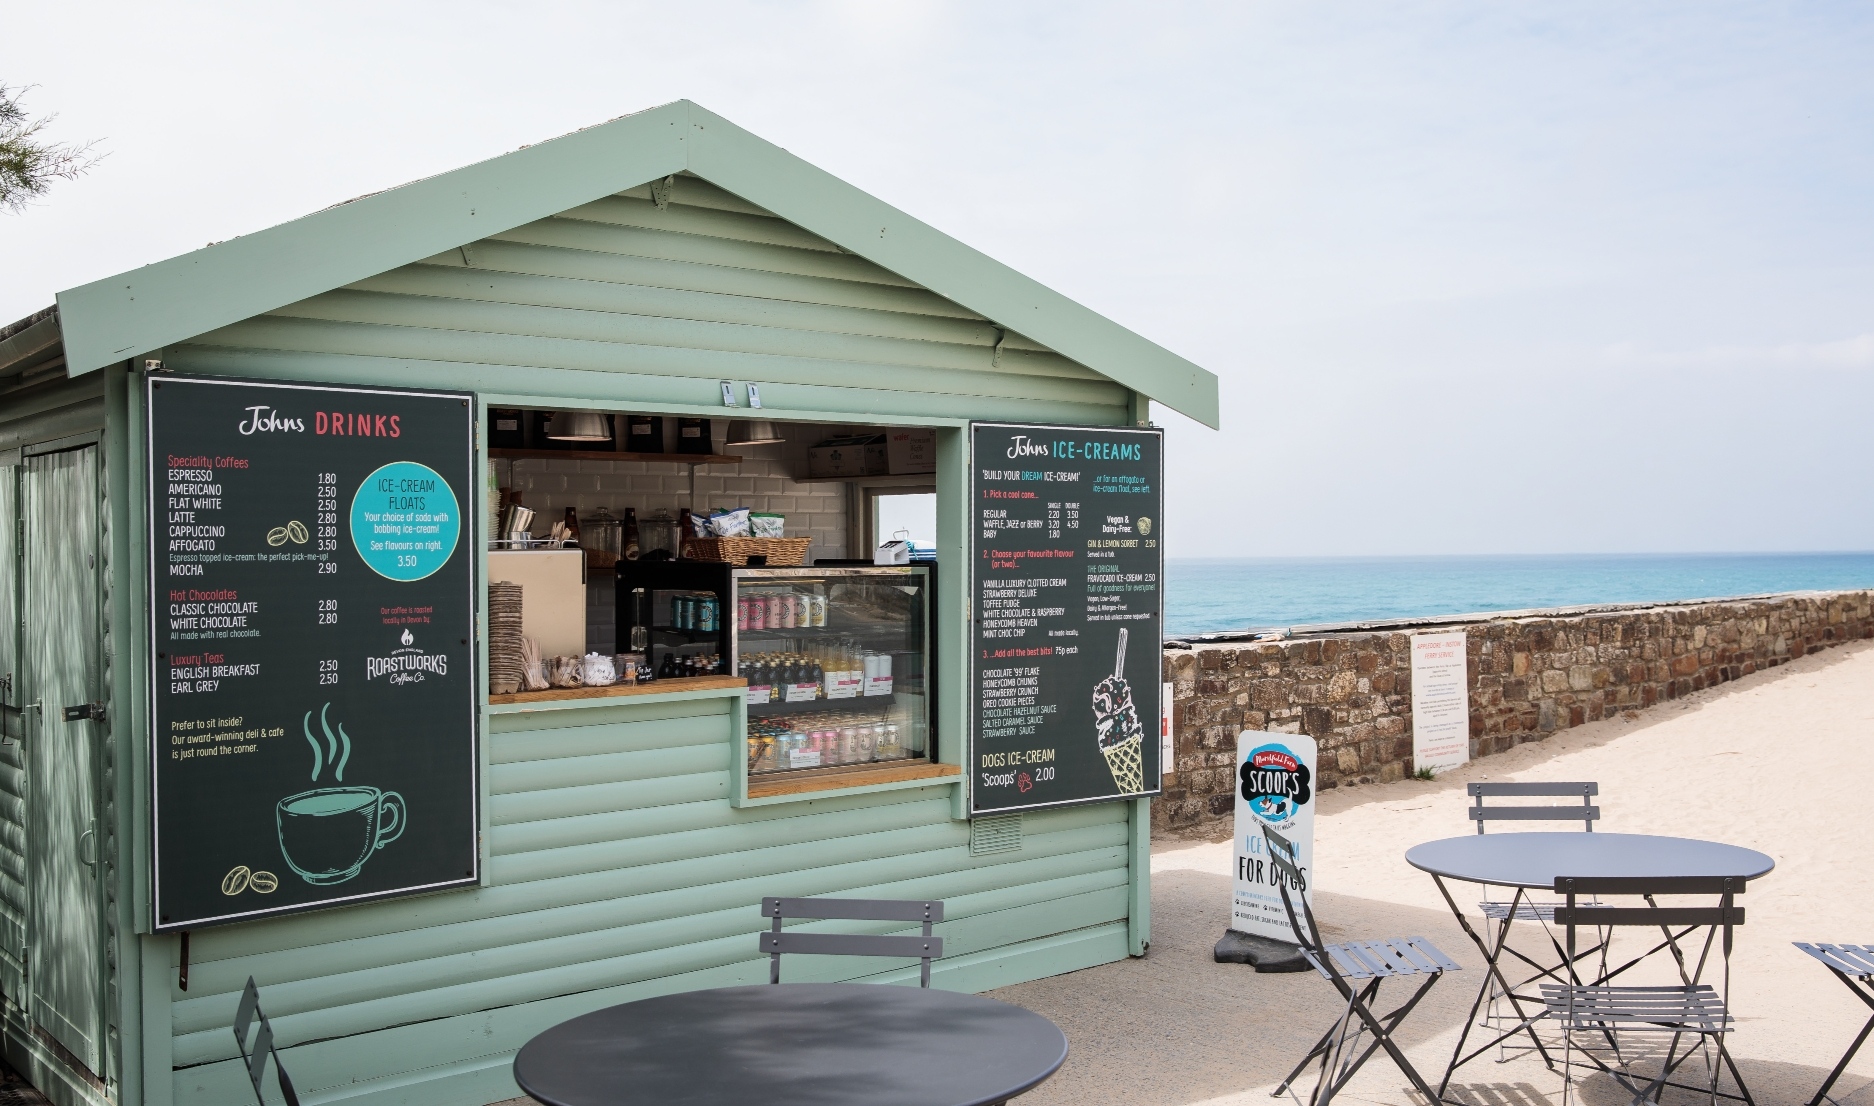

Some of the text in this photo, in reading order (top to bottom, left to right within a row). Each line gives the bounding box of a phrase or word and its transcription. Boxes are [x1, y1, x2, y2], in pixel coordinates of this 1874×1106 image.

[239, 406, 400, 437] Johns DRINKS
[893, 433, 909, 441] wafer
[1007, 436, 1140, 460] Johns ICE-CREAMS
[168, 455, 248, 470] Speciality Coffees
[169, 469, 336, 484] ESPRESSO 1.80
[1004, 471, 1020, 480] YOUR
[1022, 471, 1042, 480] DREAM
[169, 484, 336, 497] AMERICANO 2.50
[379, 479, 434, 492] ICE-CREAM
[990, 490, 1002, 498] Pick
[169, 498, 336, 510] FLAT WHITE 2.50
[390, 497, 425, 510] FLOATS
[169, 512, 336, 523] LATTE 2.80
[365, 512, 448, 522] Your choice of soda with
[984, 510, 1006, 518] REGULAR
[1107, 516, 1123, 524] Vegan
[374, 524, 439, 535] bobbing ice-cream!
[984, 520, 1005, 529] WAFFLE,
[1006, 520, 1019, 528] JAZZ
[1027, 520, 1043, 528] BERRY
[1049, 520, 1059, 528] 3.20
[1067, 520, 1078, 528] 4.50
[1103, 525, 1132, 534] Dairy-Free:
[170, 526, 336, 537] CAPPUCCINO 2.80
[984, 530, 1060, 538] BABY 1.80
[169, 540, 336, 551] AFFOGATO 3.50
[371, 541, 442, 551] See flavours on right.
[170, 554, 197, 562] Espresso
[199, 554, 221, 563] topped
[269, 553, 290, 562] perfect
[292, 553, 328, 562] pick-me-up!
[992, 550, 1012, 558] Choose
[398, 555, 417, 567] 3.50
[992, 560, 1000, 569] (or
[170, 563, 336, 575] MOCHA 2.90
[983, 580, 1005, 588] VANILLA
[1006, 579, 1026, 587] LUXURY
[1027, 579, 1048, 587] CLOTTED
[171, 589, 237, 601] Hot Chocolates
[171, 600, 337, 615] CLASSIC CHOCOLATE 2.80
[983, 599, 1020, 608] TOFFEE FUDGE
[171, 613, 337, 629] WHITE CHOCOLATE 2.80
[181, 631, 198, 639] made
[217, 630, 228, 638] real
[230, 629, 261, 637] chocolate.
[1027, 648, 1039, 656] best
[1040, 647, 1052, 655] bits!
[1056, 647, 1065, 656] 75p
[1066, 646, 1078, 654] each
[171, 653, 224, 666] Luxury Teas
[171, 660, 337, 679] ENGLISH BREAKFAST 2.50
[367, 655, 446, 680] ROASTWORKS
[983, 669, 1012, 678] CHOCOLATE
[1025, 667, 1039, 675] FLAKE
[172, 673, 338, 693] EARL GREY 2.50
[390, 672, 425, 685] Coffee Co.
[172, 717, 242, 730] Prefer to sit inside?
[172, 728, 284, 744] Our award-winning deli & cafe
[172, 745, 258, 760] is just round the corner.
[983, 749, 1054, 767] DOGS ICE-CREAM
[1036, 767, 1054, 781] 2.00
[1249, 770, 1300, 794] SCOOP'S
[1246, 835, 1262, 854] ICE
[1239, 856, 1264, 884] FOR
